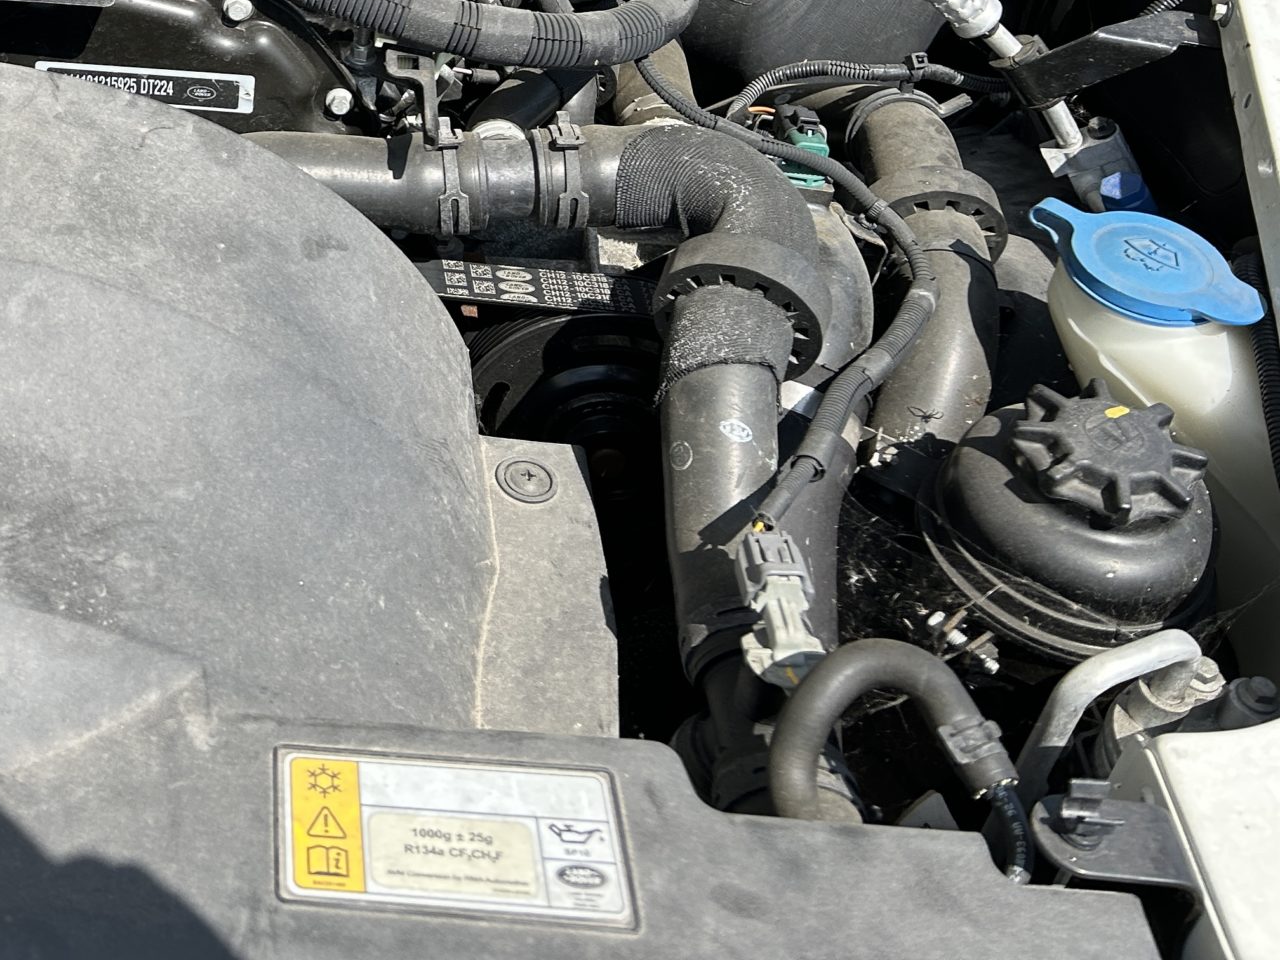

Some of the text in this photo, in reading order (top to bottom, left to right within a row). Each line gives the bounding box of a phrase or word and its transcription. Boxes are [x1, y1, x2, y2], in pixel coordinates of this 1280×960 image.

[140, 78, 174, 96] DT224
[412, 827, 453, 843] 1000g
[468, 831, 494, 846] 25g
[403, 844, 446, 858] R134a
